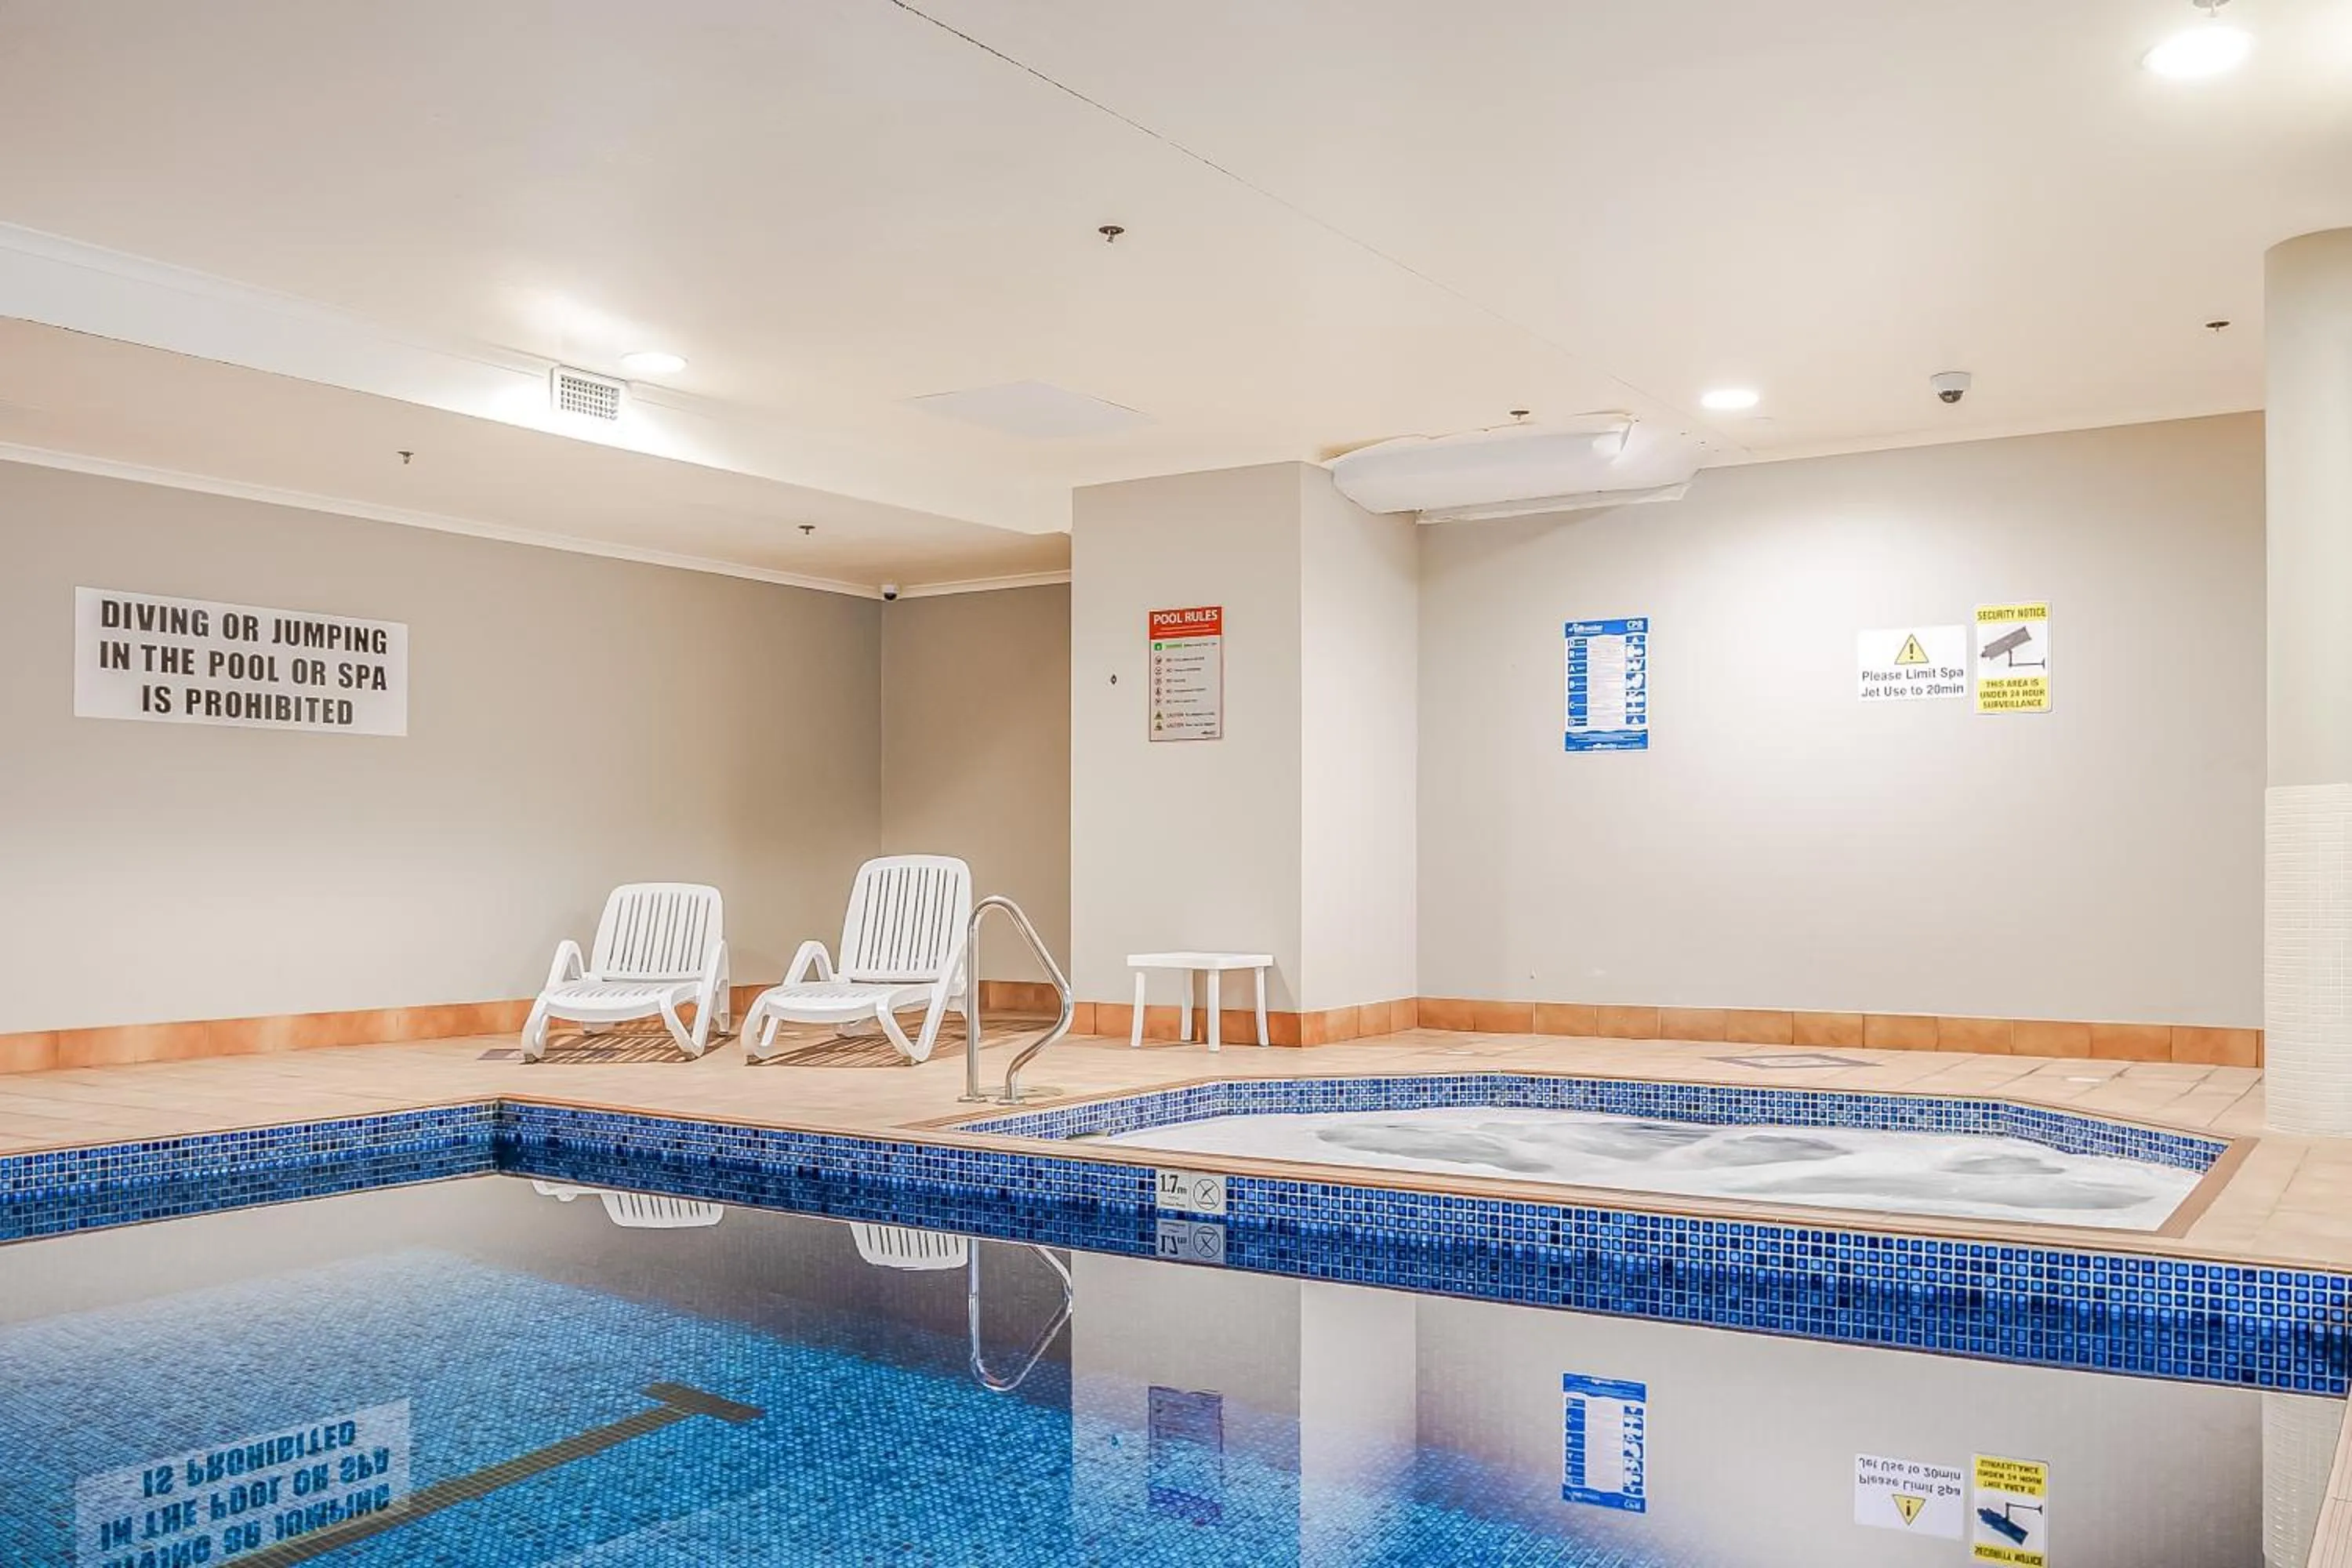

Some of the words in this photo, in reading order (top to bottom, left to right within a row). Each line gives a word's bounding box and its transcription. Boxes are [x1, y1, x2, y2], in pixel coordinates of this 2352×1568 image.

[1153, 612, 1183, 625] POOL
[1185, 609, 1218, 622] RULES
[1976, 609, 2015, 621] SECURITY
[2017, 608, 2046, 619] NOTICE
[101, 600, 210, 637] DIVING
[222, 612, 260, 642] OR
[271, 619, 388, 655] JUMPING
[100, 641, 131, 670] IN
[140, 644, 195, 675] THE
[209, 651, 279, 682] POOL
[292, 658, 326, 686] OR
[338, 663, 388, 691] SPA
[1862, 670, 1902, 681] Please
[1906, 668, 1936, 680] Limit
[1940, 666, 1964, 680] Spa
[1861, 686, 1881, 697] Jet
[1884, 685, 1907, 697] Use
[1911, 685, 1923, 696] to
[1926, 684, 1964, 695] 20min
[1986, 680, 2005, 688] THIS
[2006, 679, 2028, 688] AREA
[1980, 691, 2008, 699] UNDER
[142, 684, 172, 713] IS
[186, 688, 354, 725] PROHIBITED
[1983, 699, 2042, 709] SURVEILLANCE
